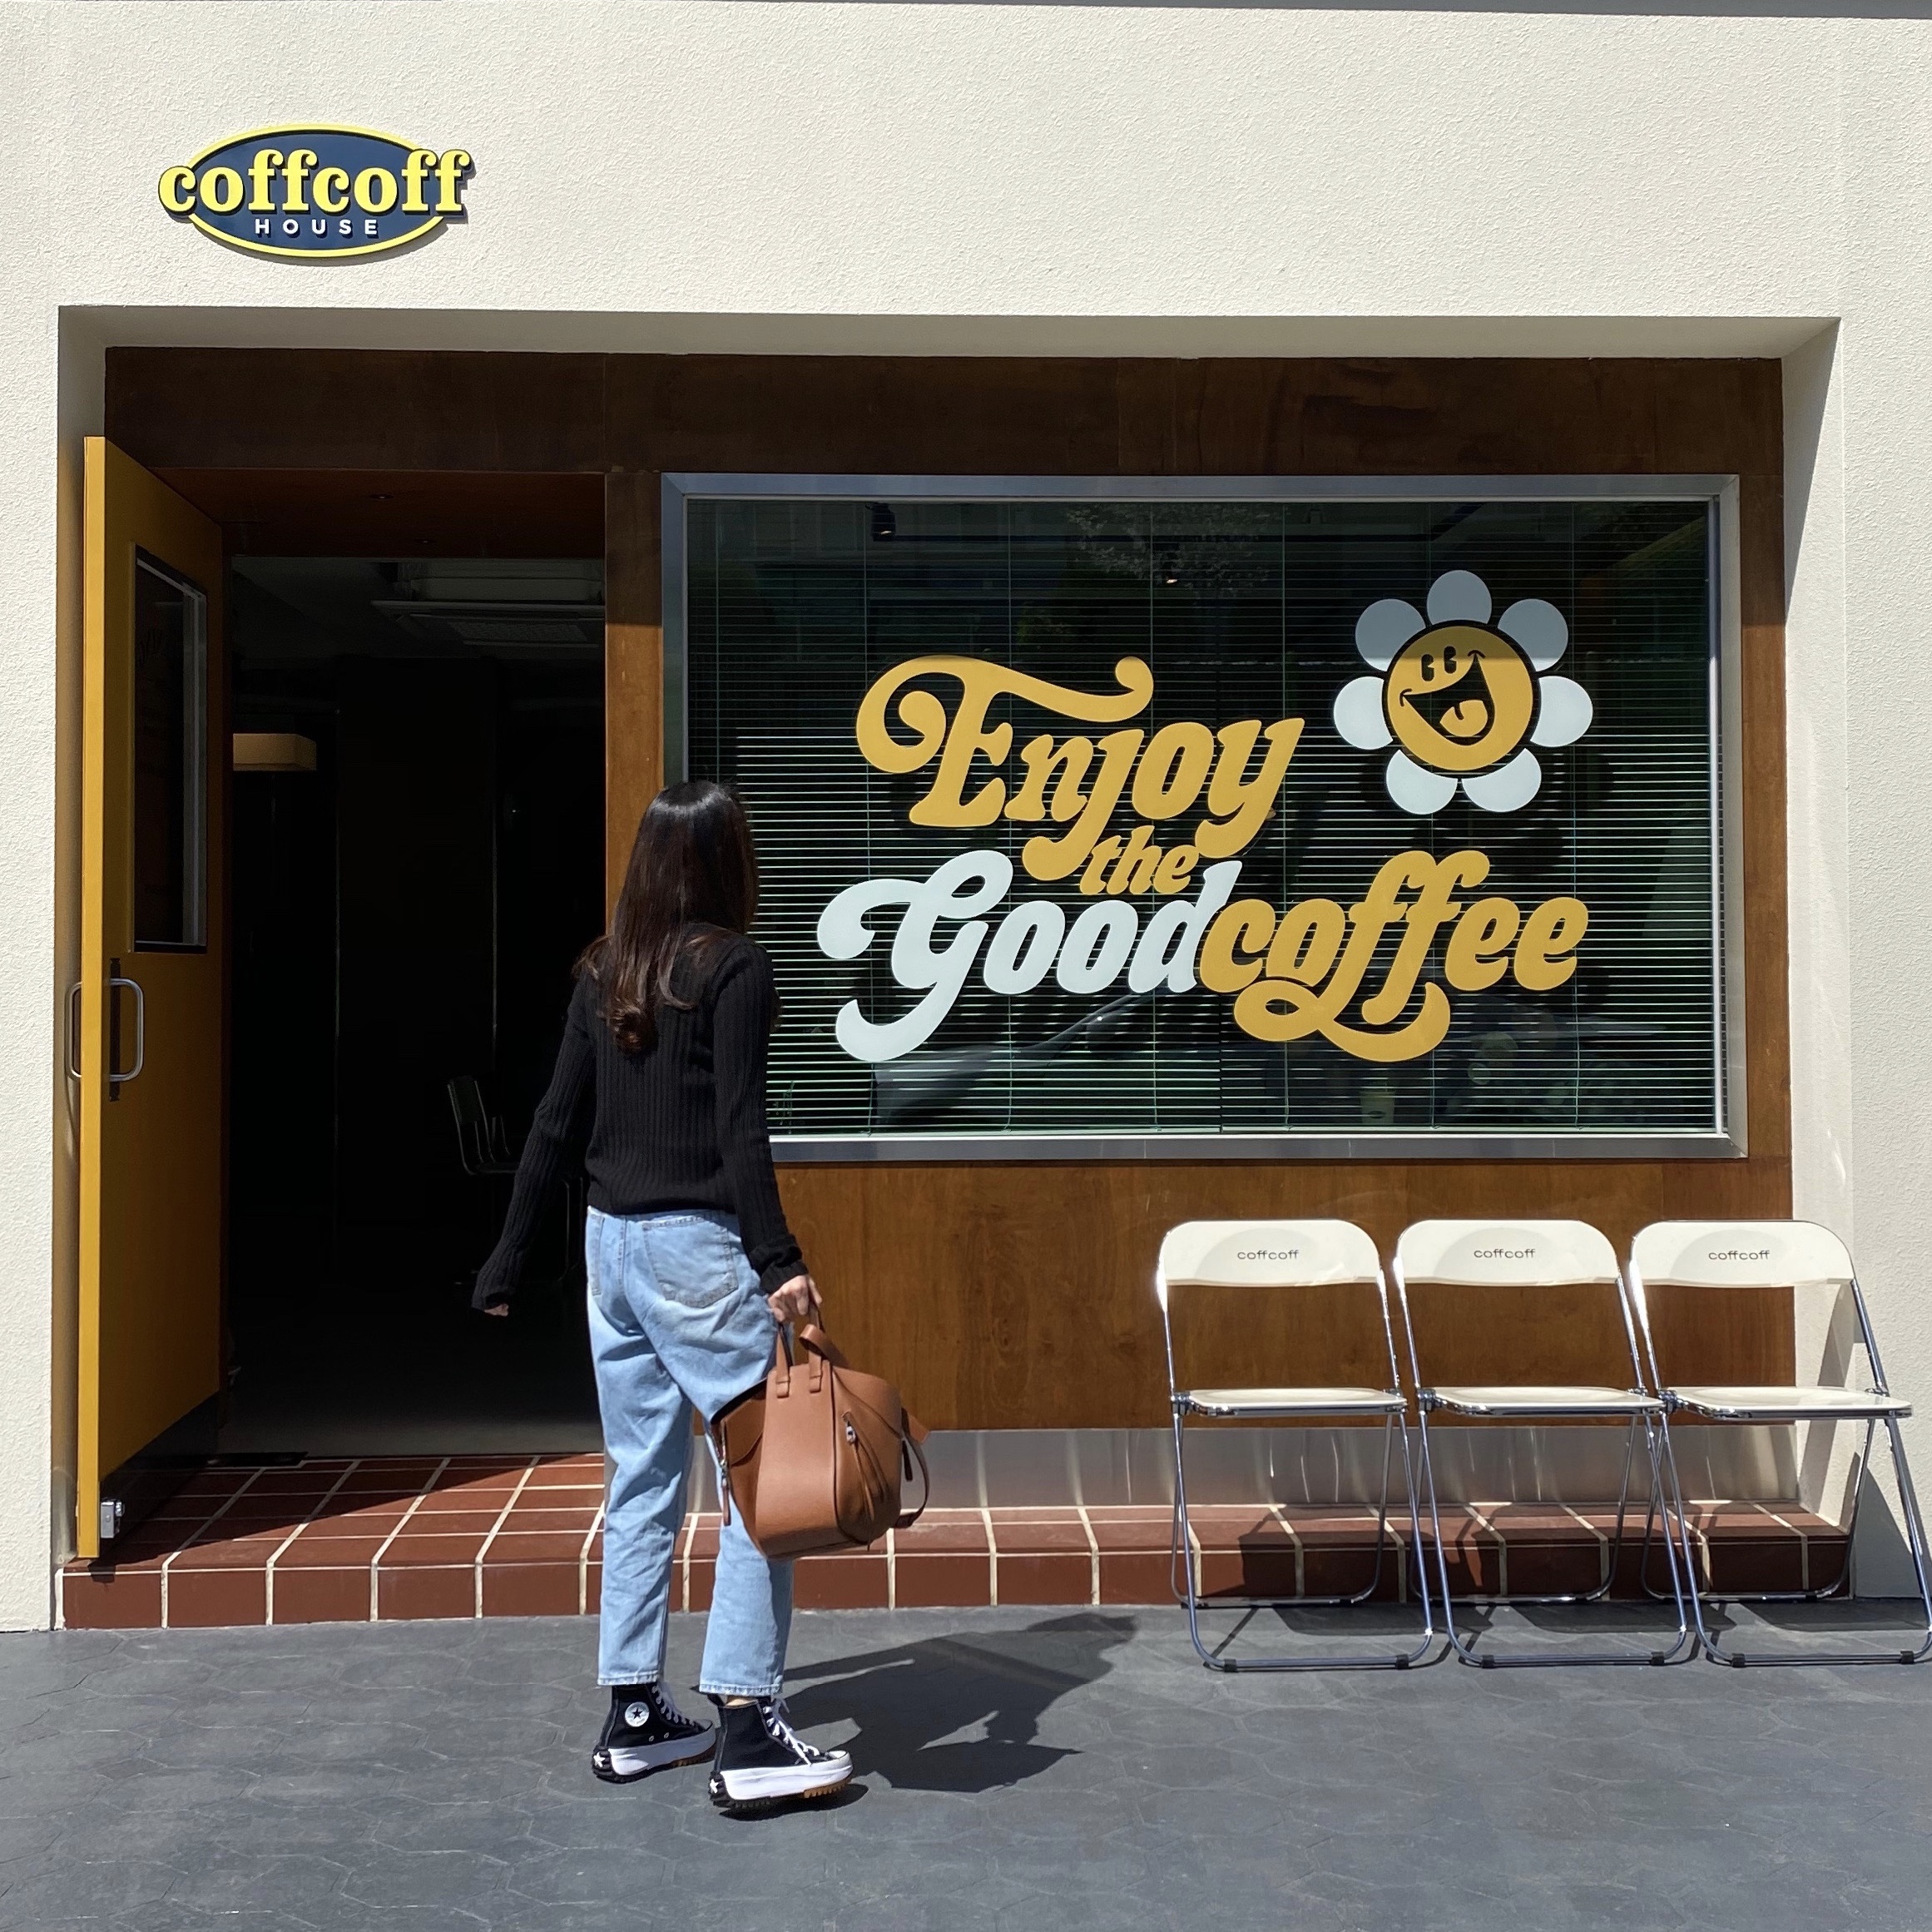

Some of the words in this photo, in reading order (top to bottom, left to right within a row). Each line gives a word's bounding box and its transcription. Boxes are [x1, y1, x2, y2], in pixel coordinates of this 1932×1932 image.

[158, 148, 471, 213] coffcoff
[255, 218, 378, 235] HOUSE
[855, 655, 1305, 881] Enjoy
[1079, 825, 1199, 895] the
[816, 850, 1242, 1062] Good
[1199, 850, 1589, 1062] coffee
[1236, 1249, 1300, 1261] coffcoff
[1473, 1248, 1536, 1259] coffcoff
[1707, 1250, 1771, 1261] coffcoff
